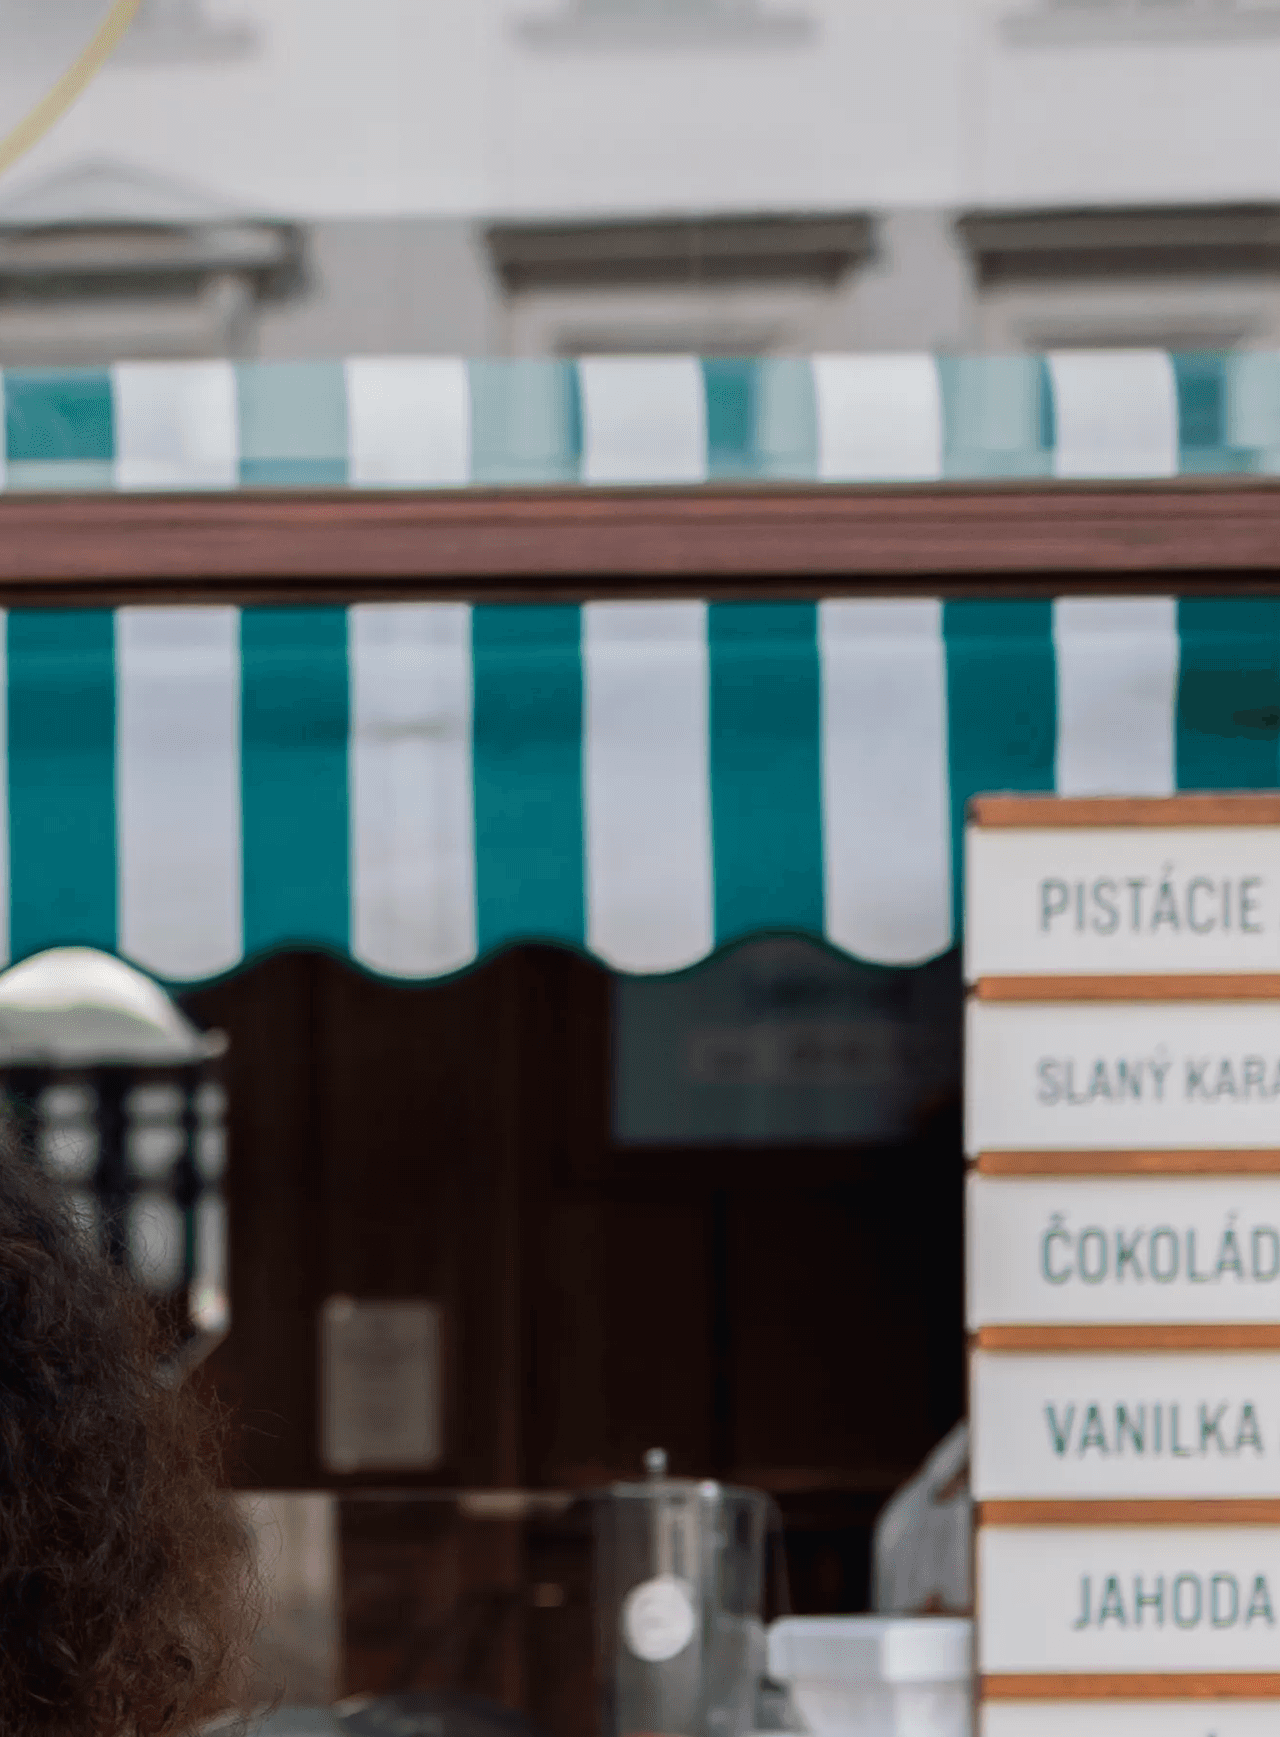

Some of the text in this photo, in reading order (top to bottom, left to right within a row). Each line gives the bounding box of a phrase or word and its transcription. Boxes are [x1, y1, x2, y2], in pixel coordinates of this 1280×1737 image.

[1037, 861, 1266, 935] PISTÁCIE
[1035, 1045, 1173, 1106] SLANÝ
[1044, 1401, 1263, 1458] VANILKA
[1072, 1571, 1274, 1632] JAHODA
